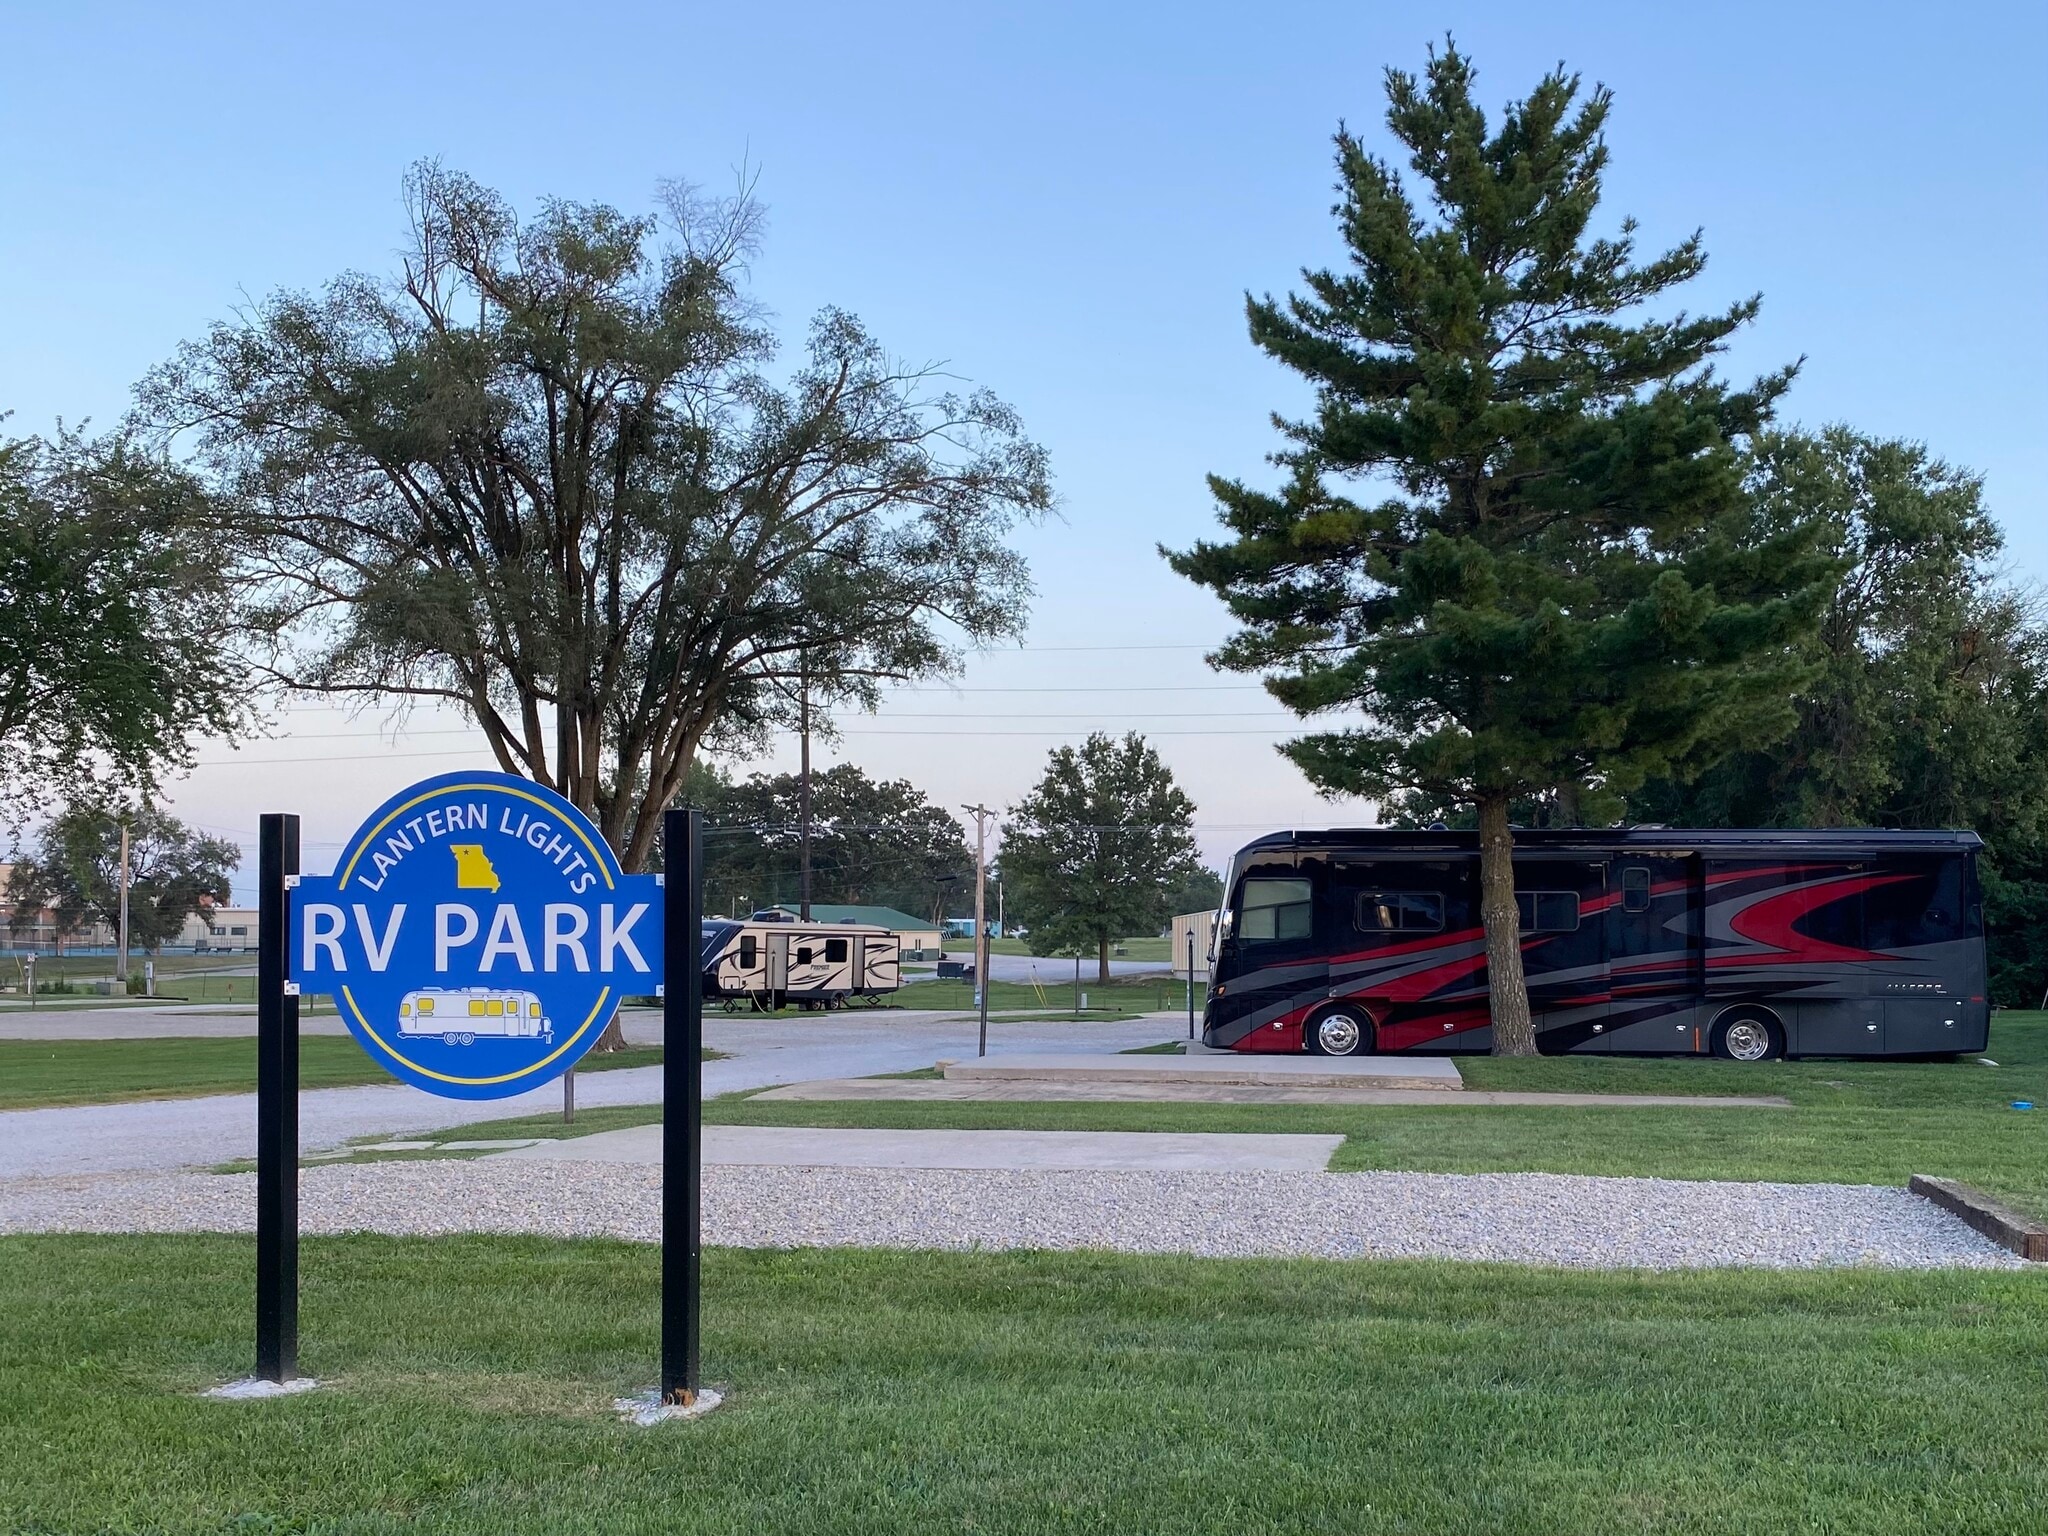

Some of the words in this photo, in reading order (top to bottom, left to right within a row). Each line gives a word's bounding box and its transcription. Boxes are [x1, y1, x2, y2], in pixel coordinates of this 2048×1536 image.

[358, 803, 488, 892] LANTERN
[499, 806, 597, 894] LIGHTS
[302, 903, 407, 972] RV
[434, 903, 652, 972] PARK
